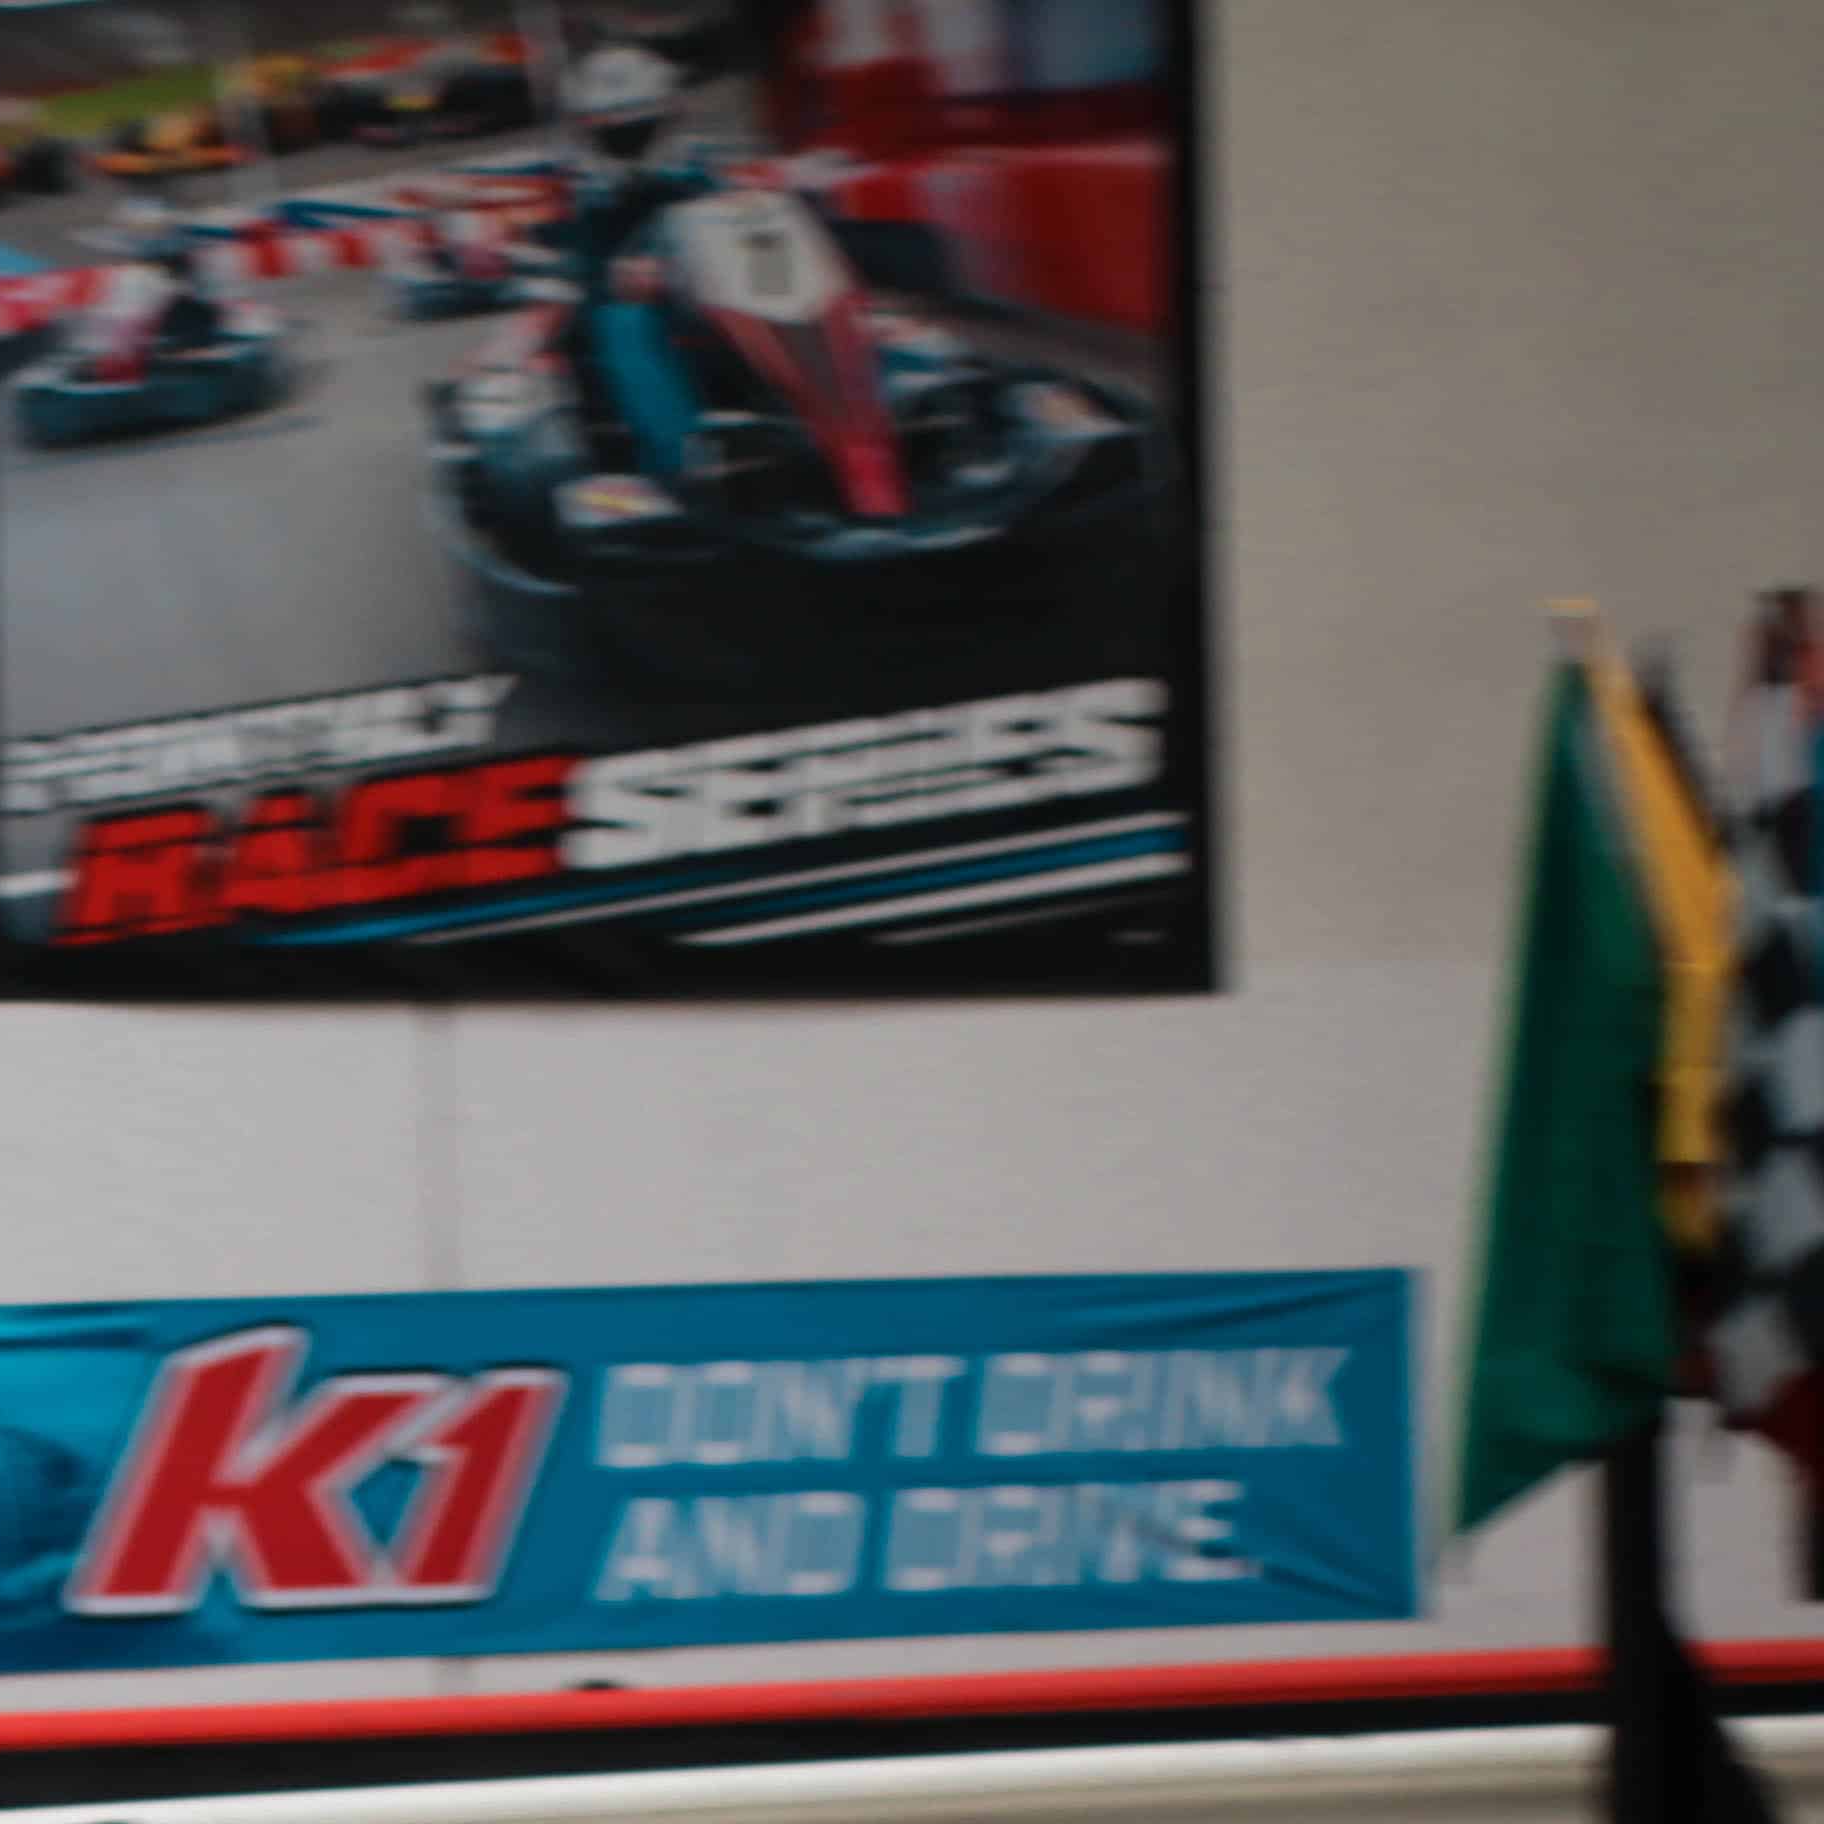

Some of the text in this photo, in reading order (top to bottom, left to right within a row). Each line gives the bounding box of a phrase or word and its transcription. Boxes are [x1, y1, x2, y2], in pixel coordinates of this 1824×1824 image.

[592, 1346, 1350, 1468] DON'T DRINK
[62, 1325, 570, 1614] K1
[592, 1490, 866, 1602] AND
